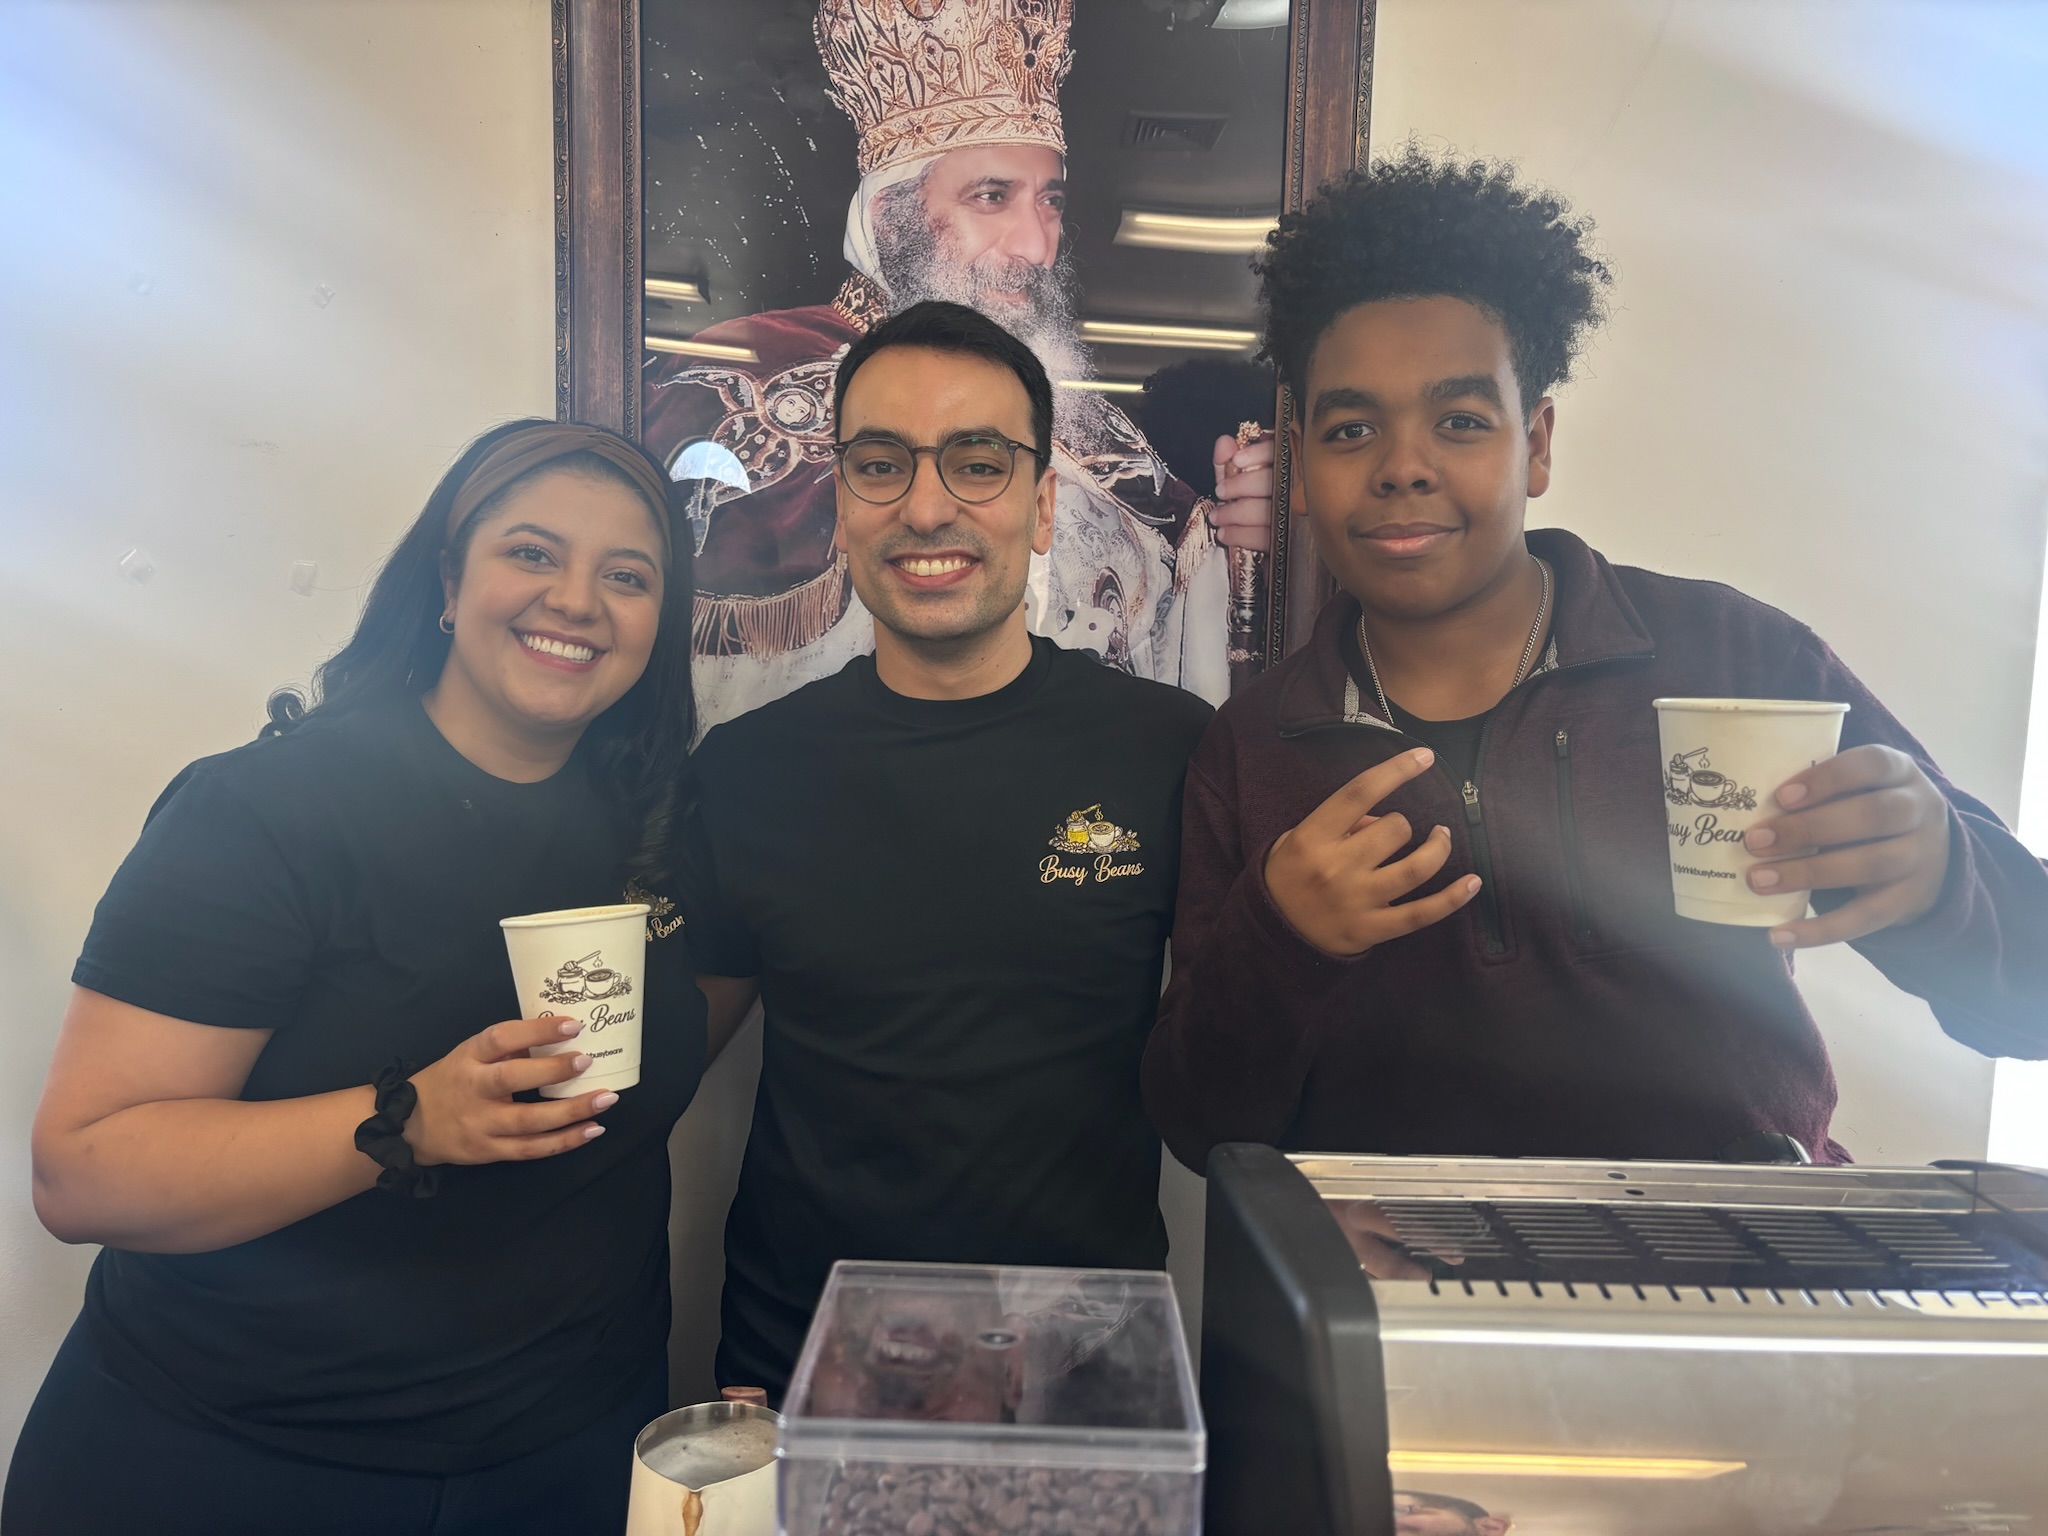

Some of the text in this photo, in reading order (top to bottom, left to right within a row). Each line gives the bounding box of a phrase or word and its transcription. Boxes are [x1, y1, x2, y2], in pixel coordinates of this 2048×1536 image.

[1667, 807, 1744, 847] usy Bea
[1039, 854, 1145, 887] Busy Beans
[651, 915, 686, 939] Bean
[590, 1003, 637, 1033] Beans
